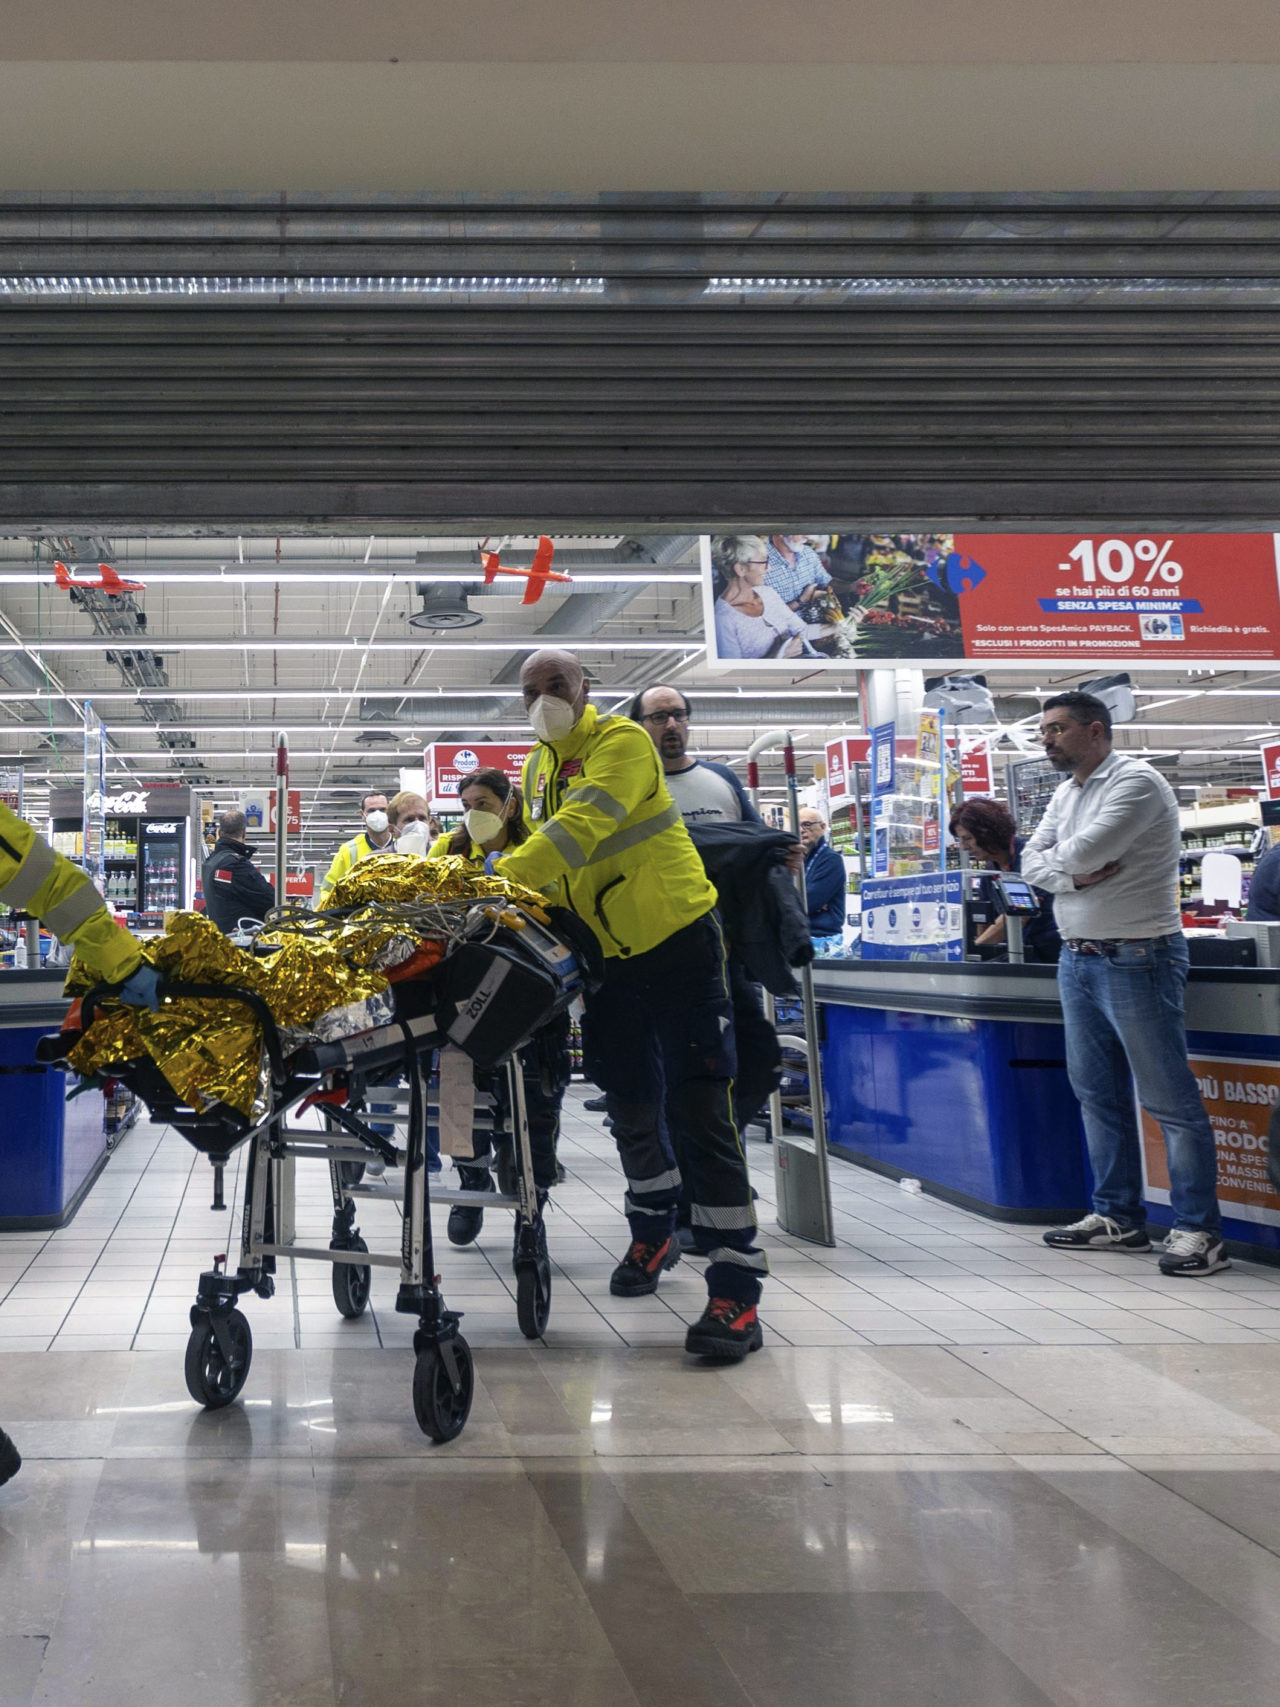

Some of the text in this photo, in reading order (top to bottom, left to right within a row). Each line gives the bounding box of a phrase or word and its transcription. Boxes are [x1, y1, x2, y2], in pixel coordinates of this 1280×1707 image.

[1058, 539, 1183, 583] -10%
[1056, 585, 1180, 599] se hai più di 60 anni
[1057, 601, 1095, 611] SENZA
[1097, 601, 1133, 611] SPESA
[976, 624, 996, 632] Solo
[1079, 640, 1141, 648] PROMOZIONE
[466, 991, 491, 1020] ZOLL
[1209, 1115, 1248, 1130] FINO A
[1240, 1155, 1269, 1167] SPES
